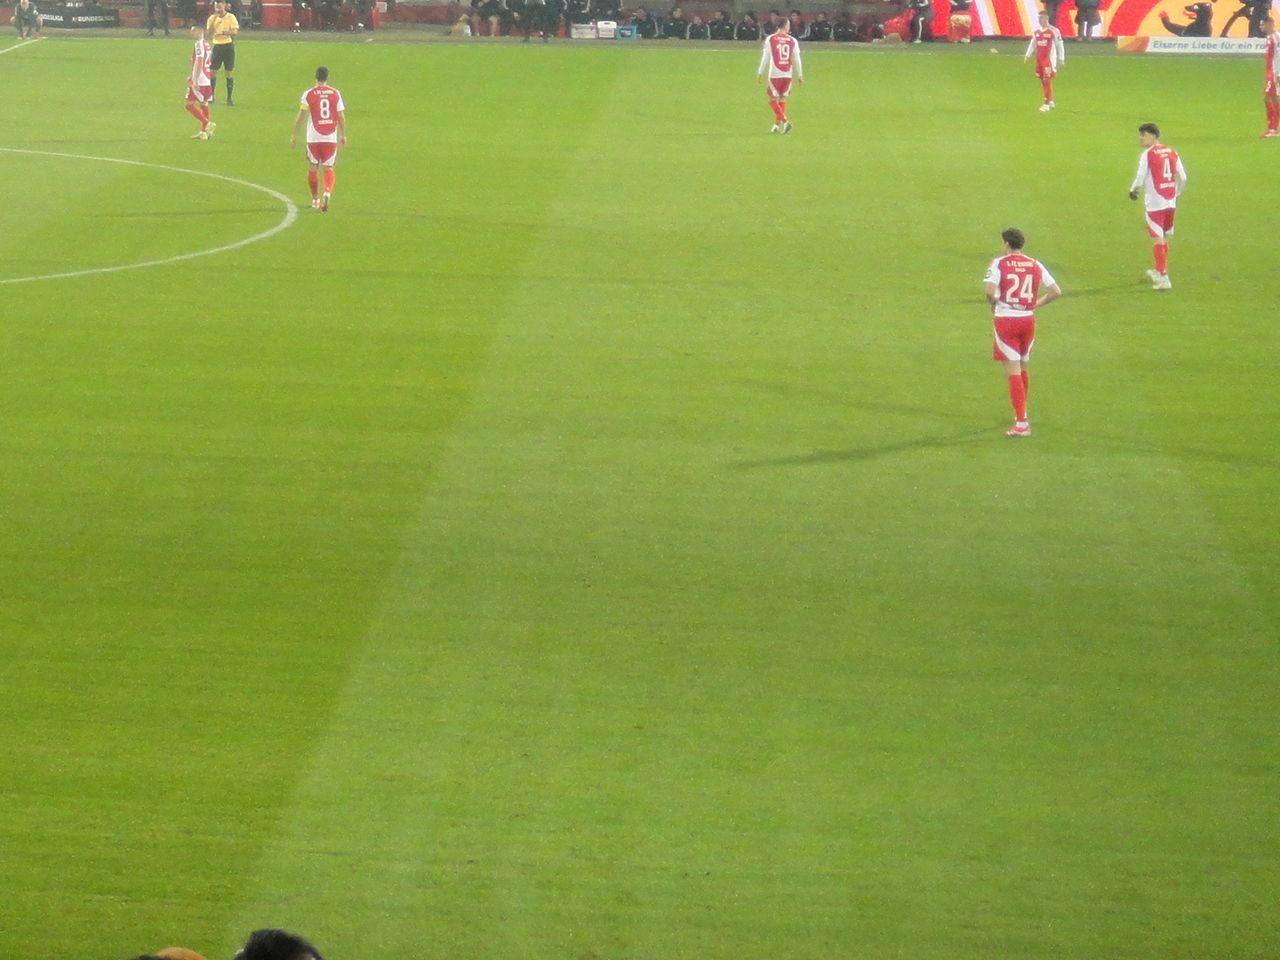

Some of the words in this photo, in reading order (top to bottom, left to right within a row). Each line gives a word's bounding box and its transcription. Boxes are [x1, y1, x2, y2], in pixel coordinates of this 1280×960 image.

[777, 44, 790, 61] 19
[1153, 40, 1189, 49] Eiserne
[1192, 40, 1216, 49] Liebe
[1220, 41, 1235, 50] für
[1238, 41, 1252, 49] ein
[320, 99, 330, 119] 8
[1163, 158, 1172, 181] 4
[1006, 273, 1034, 303] 24
